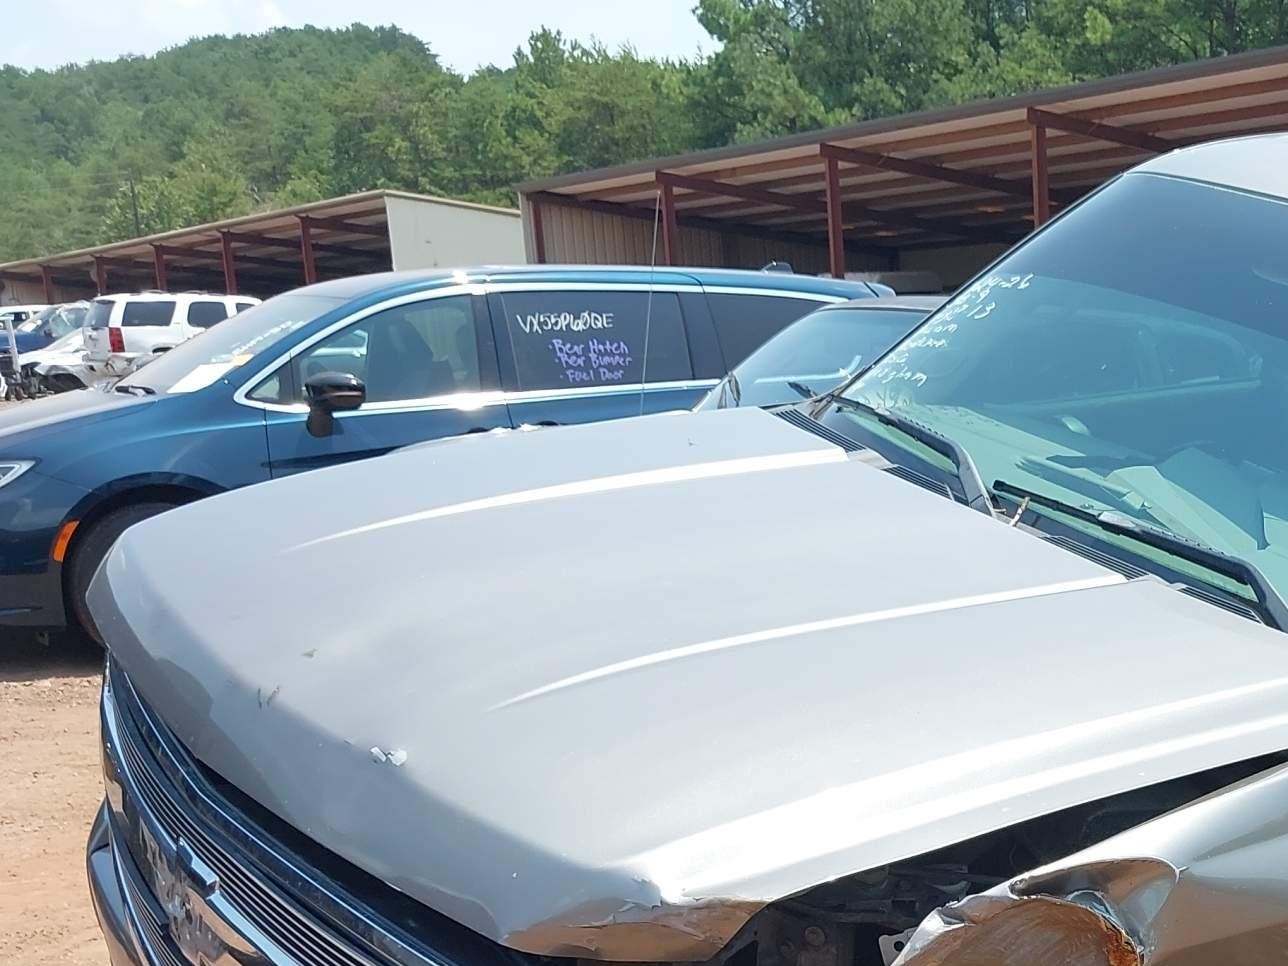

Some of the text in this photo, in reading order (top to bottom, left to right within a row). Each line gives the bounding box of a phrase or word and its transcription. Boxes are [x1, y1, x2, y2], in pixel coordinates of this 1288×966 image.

[589, 338, 629, 354] Hatch
[590, 353, 632, 368] Bumper
[567, 368, 624, 382] Fuel Door
